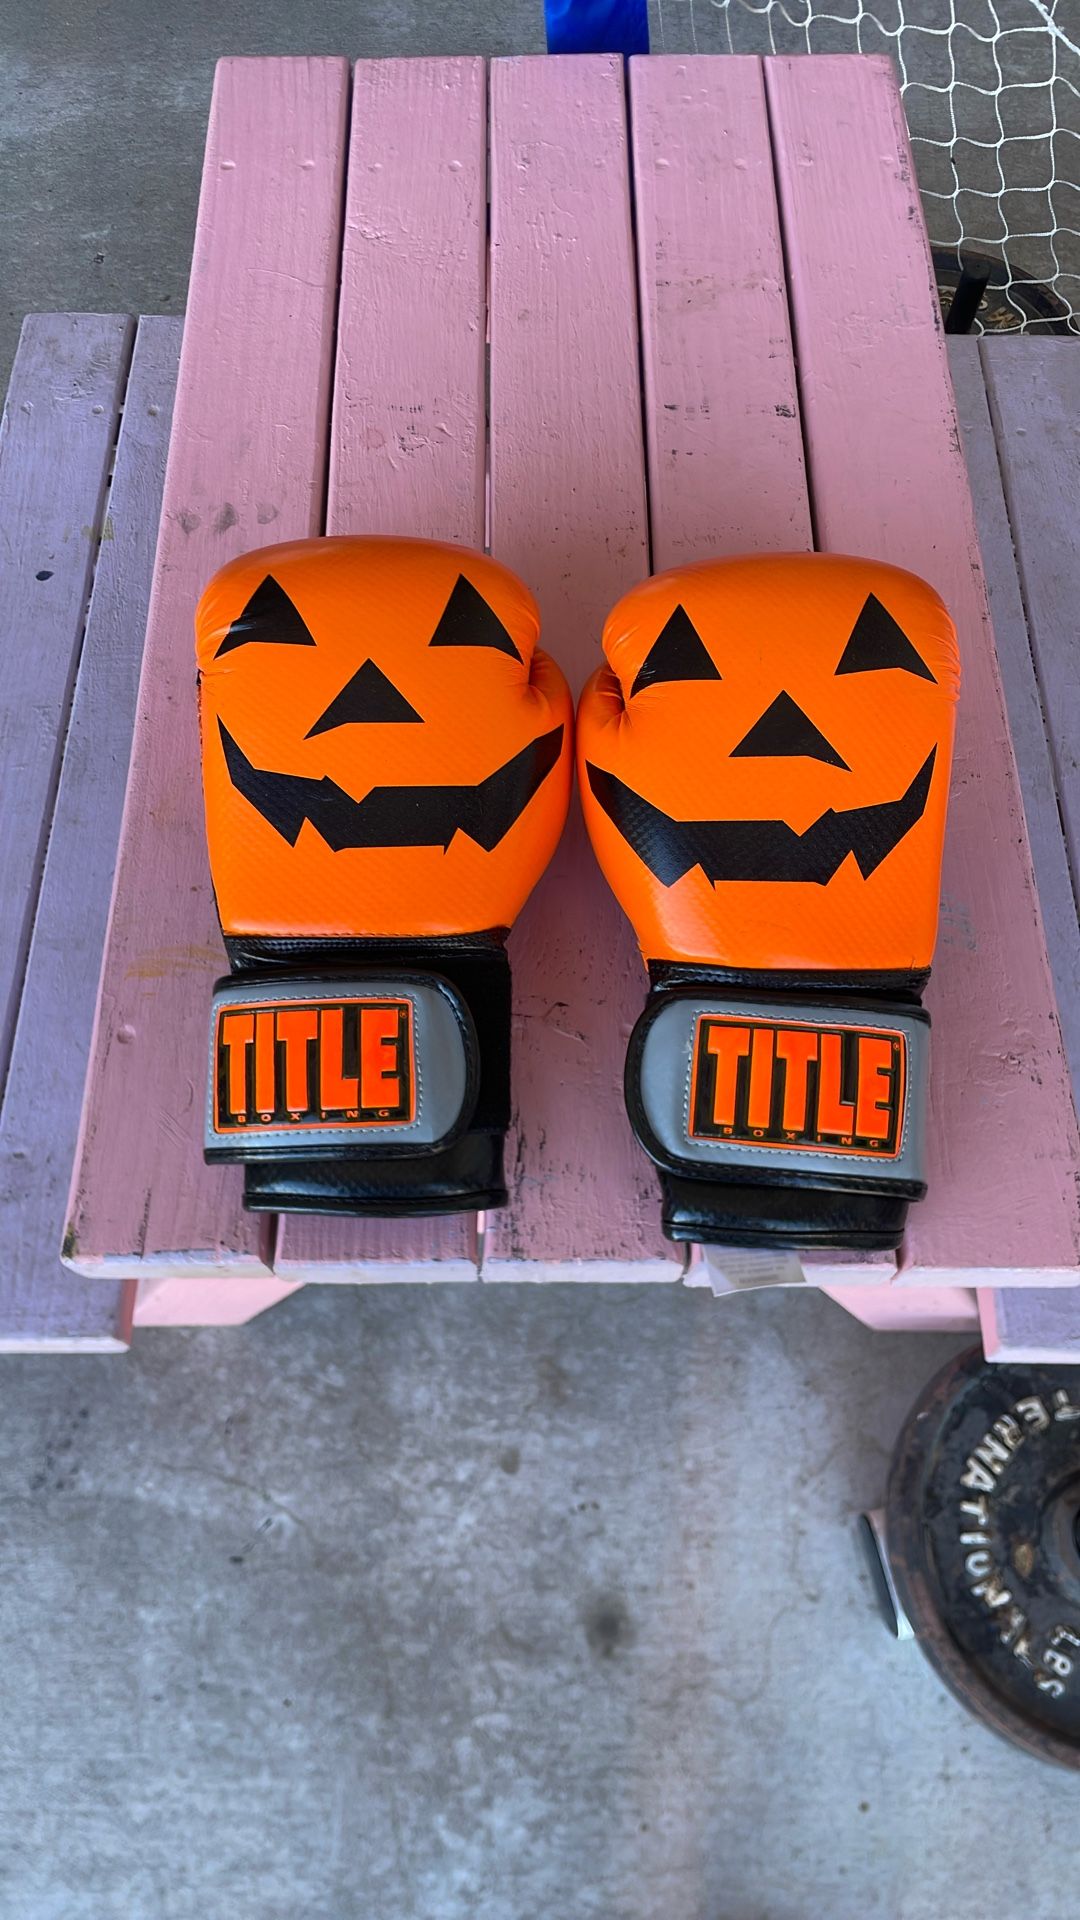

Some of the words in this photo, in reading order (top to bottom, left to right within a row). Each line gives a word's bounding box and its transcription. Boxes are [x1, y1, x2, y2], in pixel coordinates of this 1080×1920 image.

[223, 1008, 400, 1115] TITLE
[707, 1025, 893, 1140] TITLE
[236, 1109, 390, 1124] BOXING
[723, 1127, 880, 1148] BOXING
